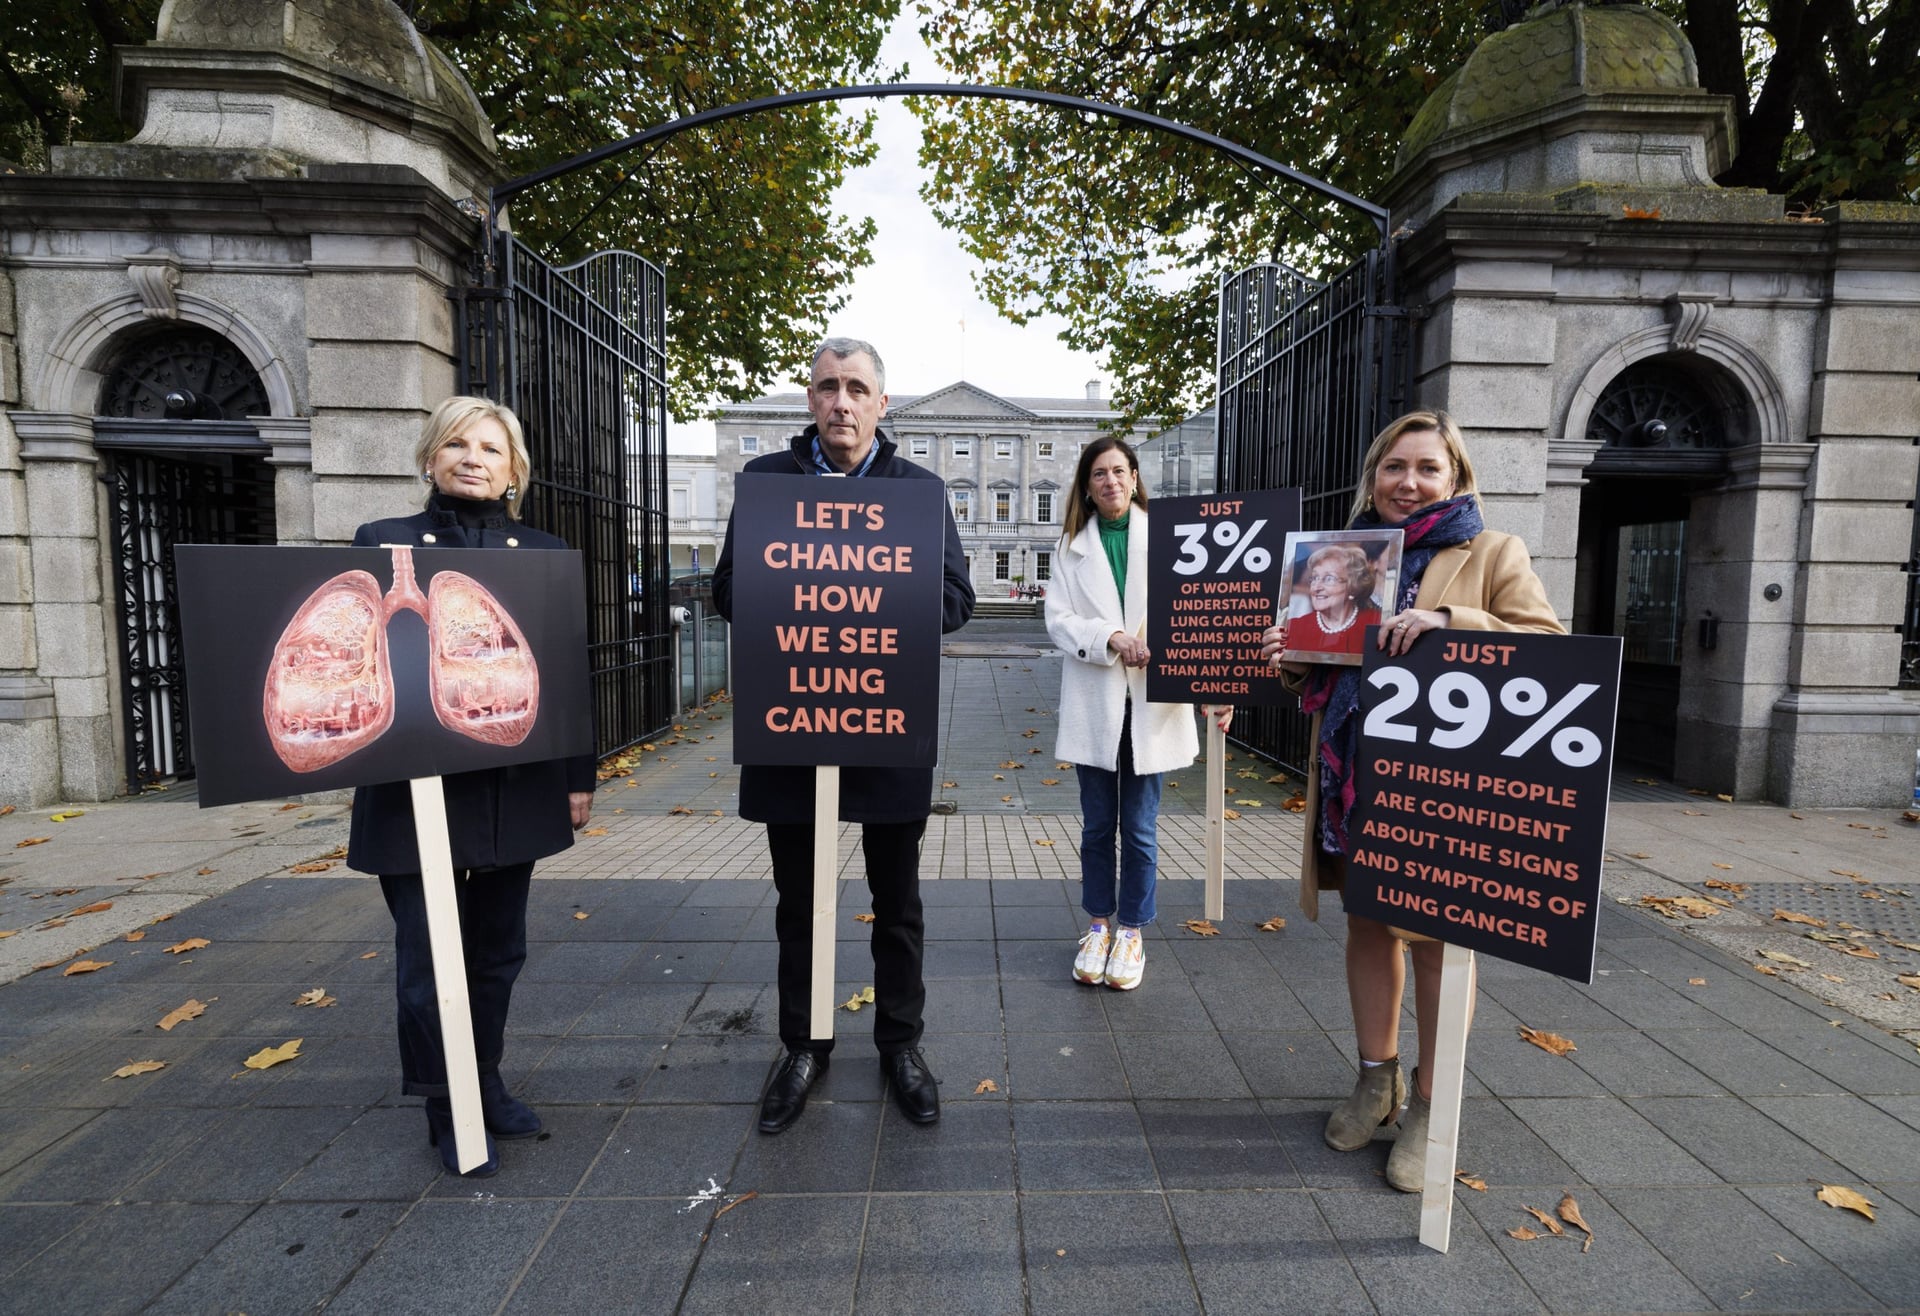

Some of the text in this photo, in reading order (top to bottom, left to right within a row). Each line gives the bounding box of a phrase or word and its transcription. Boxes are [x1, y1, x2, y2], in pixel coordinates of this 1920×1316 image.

[795, 500, 885, 531] LET’S
[1199, 500, 1243, 517] JUST
[763, 542, 913, 573] CHANGE
[1172, 519, 1272, 576] 3%
[794, 584, 883, 613] HOW
[1180, 581, 1261, 595] OF WOMEN
[1172, 597, 1271, 611] UNDERSTAND
[1170, 614, 1272, 627] LUNG CANCER
[775, 625, 898, 655] WE SEE
[1171, 631, 1262, 644] CLAIMS MOR
[1165, 648, 1233, 661] WOMEN’S
[1442, 641, 1517, 666] JUST
[789, 666, 886, 695] LUNG
[1159, 664, 1198, 677] THAN
[1200, 665, 1230, 677] ANY
[1190, 681, 1249, 694] CANCER
[765, 705, 906, 735] CANCER
[1363, 665, 1602, 768] 29%
[1373, 758, 1577, 809] OF IRISH PEOPLE
[1373, 790, 1572, 843] ARE CONFIDENT
[1362, 819, 1579, 882] ABOUT THE SIGNS
[1353, 848, 1587, 920] AND SYMPTOMS OF
[1376, 885, 1549, 948] LUNG CANCER
